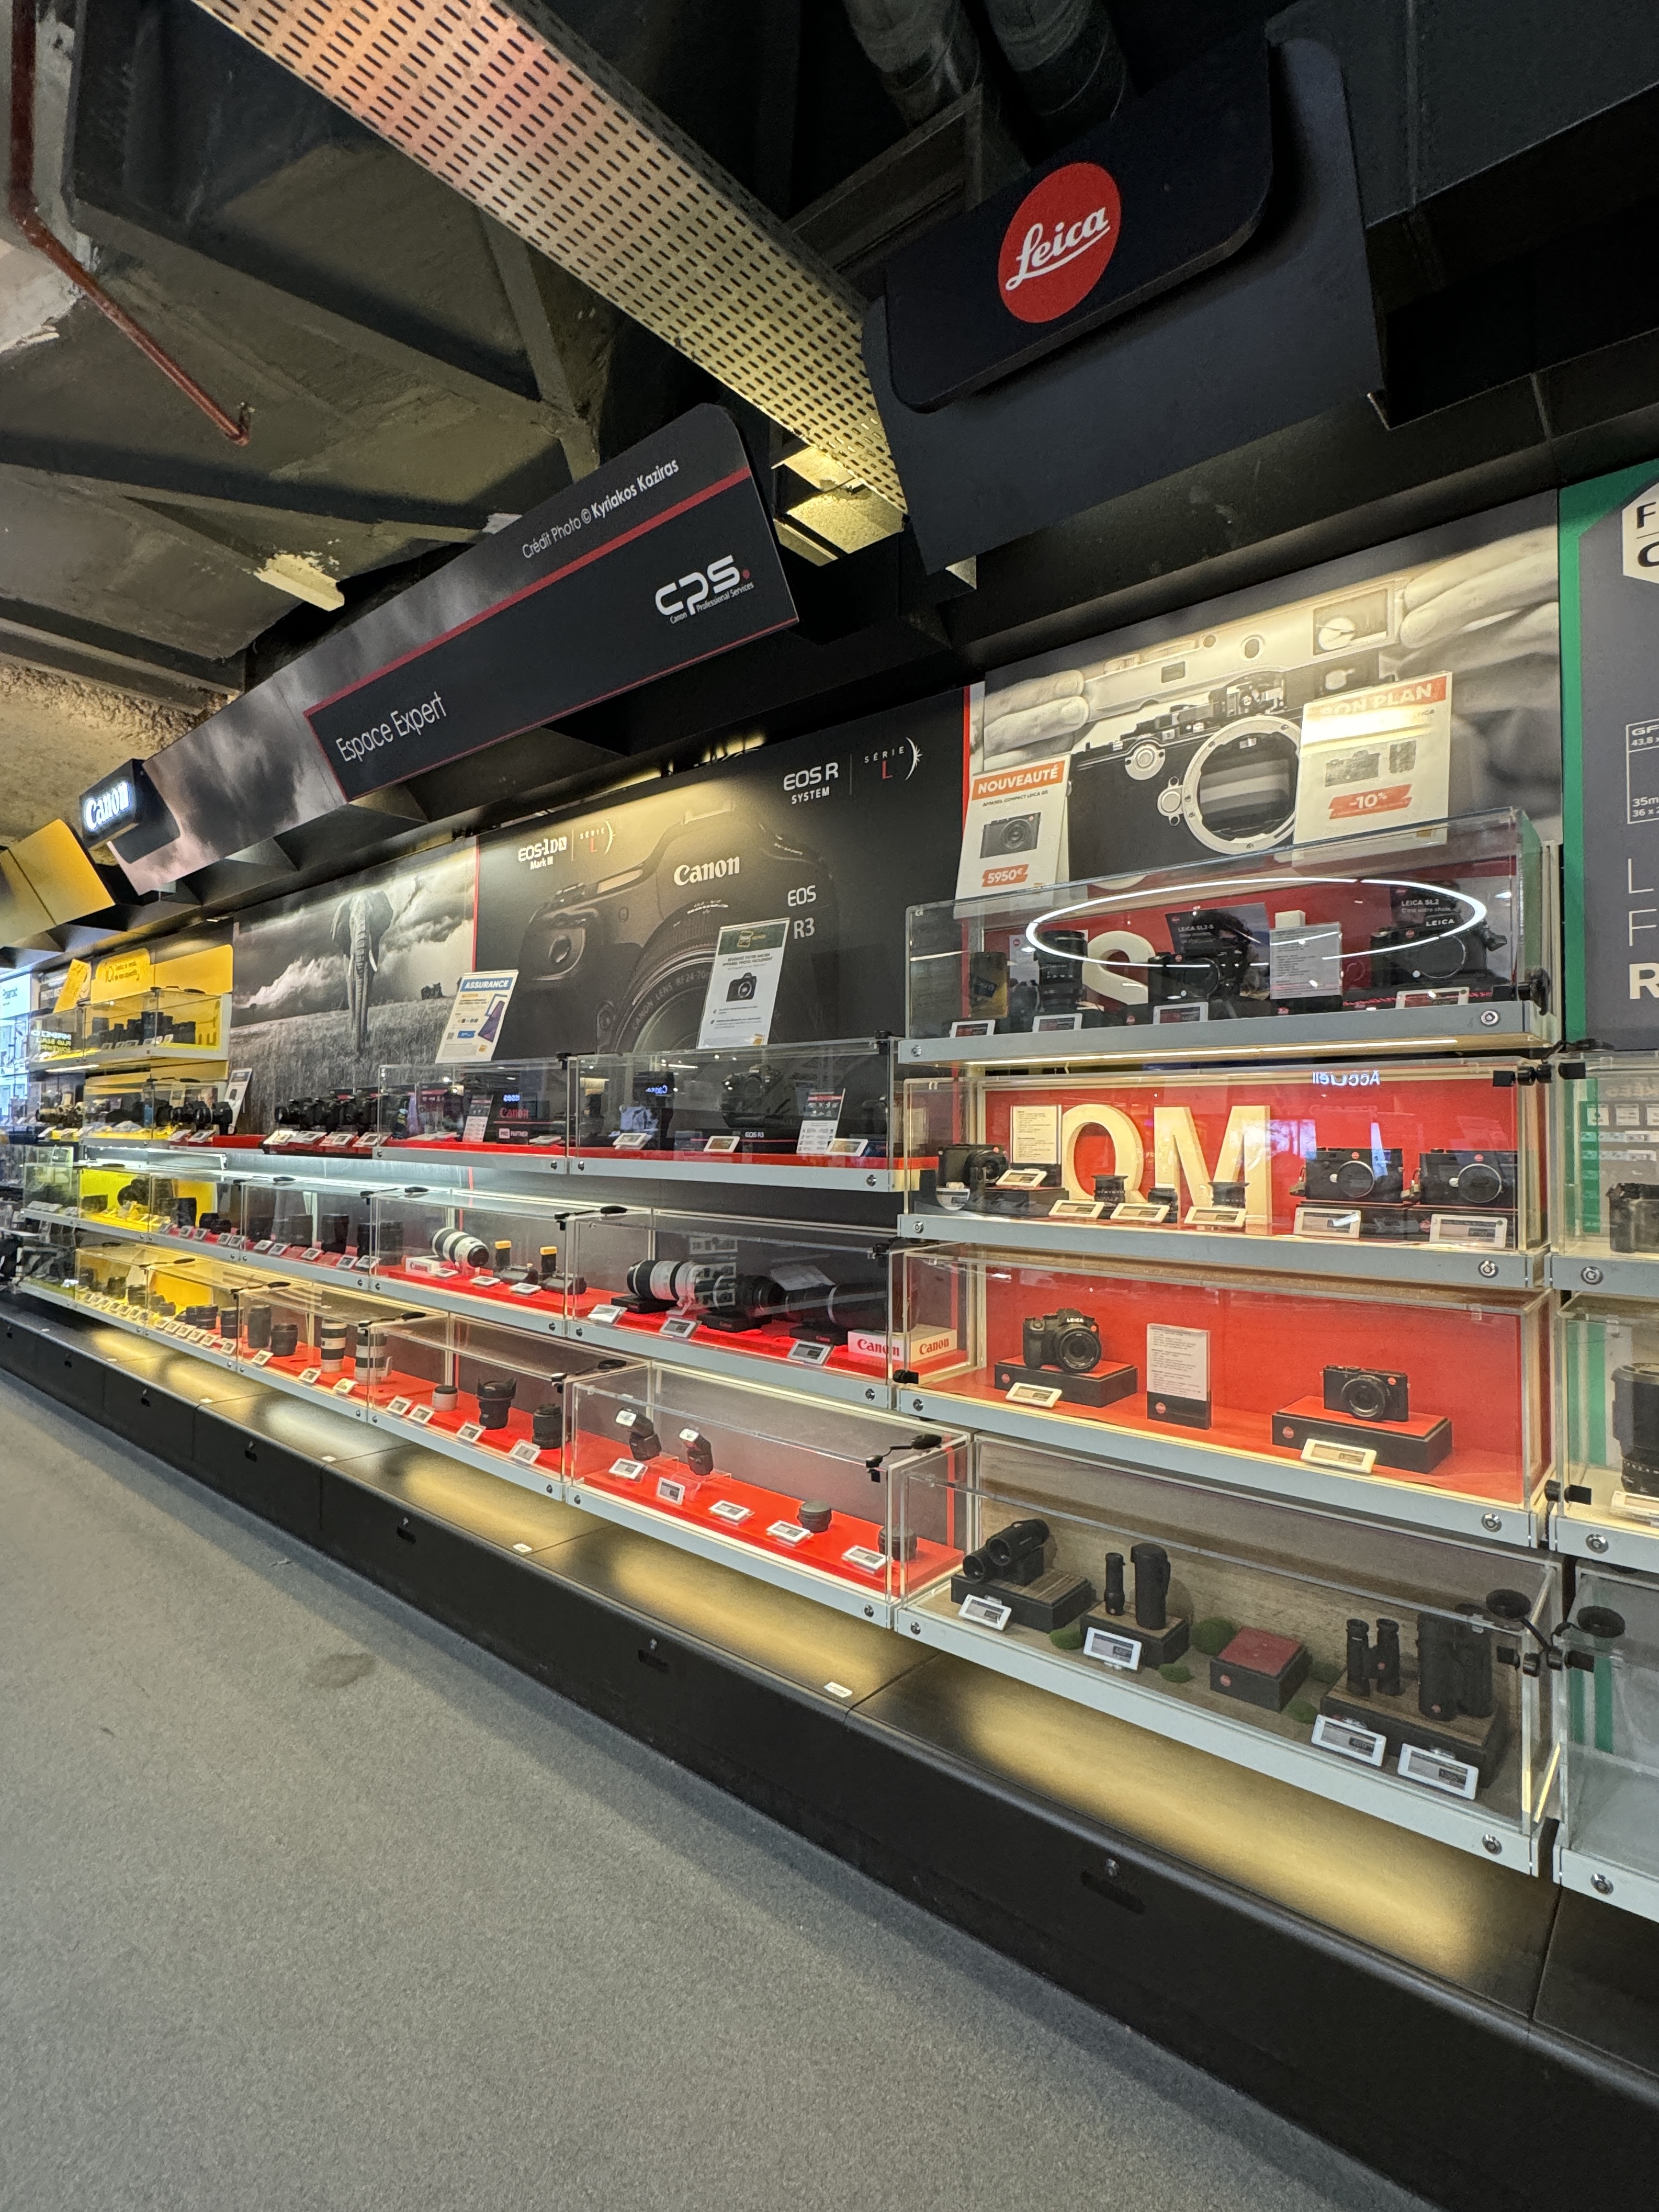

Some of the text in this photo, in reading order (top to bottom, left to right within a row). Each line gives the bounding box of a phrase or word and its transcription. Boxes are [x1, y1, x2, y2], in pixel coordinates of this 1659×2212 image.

[1005, 207, 1110, 291] Leica
[522, 533, 551, 558] Crédit
[551, 516, 582, 542] Photo
[590, 484, 637, 519] Kyriakos
[636, 460, 679, 493] Kaziras
[669, 582, 755, 624] Canon Professional Services
[1372, 683, 1432, 709] PLAN
[335, 691, 447, 762] Espace Expert
[783, 762, 839, 791] EOS R
[882, 760, 893, 780] L
[978, 764, 1059, 794] NOUVEAUTÉ
[84, 781, 131, 832] Canon
[791, 786, 830, 805] SYSTEM
[1632, 809, 1646, 817] 36
[590, 837, 598, 853] L
[530, 857, 546, 870] Mark
[674, 856, 740, 886] Canon
[987, 868, 1023, 884] 5950€
[788, 885, 816, 907] EOS
[793, 917, 815, 939] R3
[1425, 918, 1455, 927] LEICA
[464, 980, 509, 989] ASSURANCE
[632, 1000, 654, 1030] CANON
[655, 981, 673, 1001] LENS
[499, 1107, 529, 1119] Canon
[919, 1338, 949, 1355] Canon
